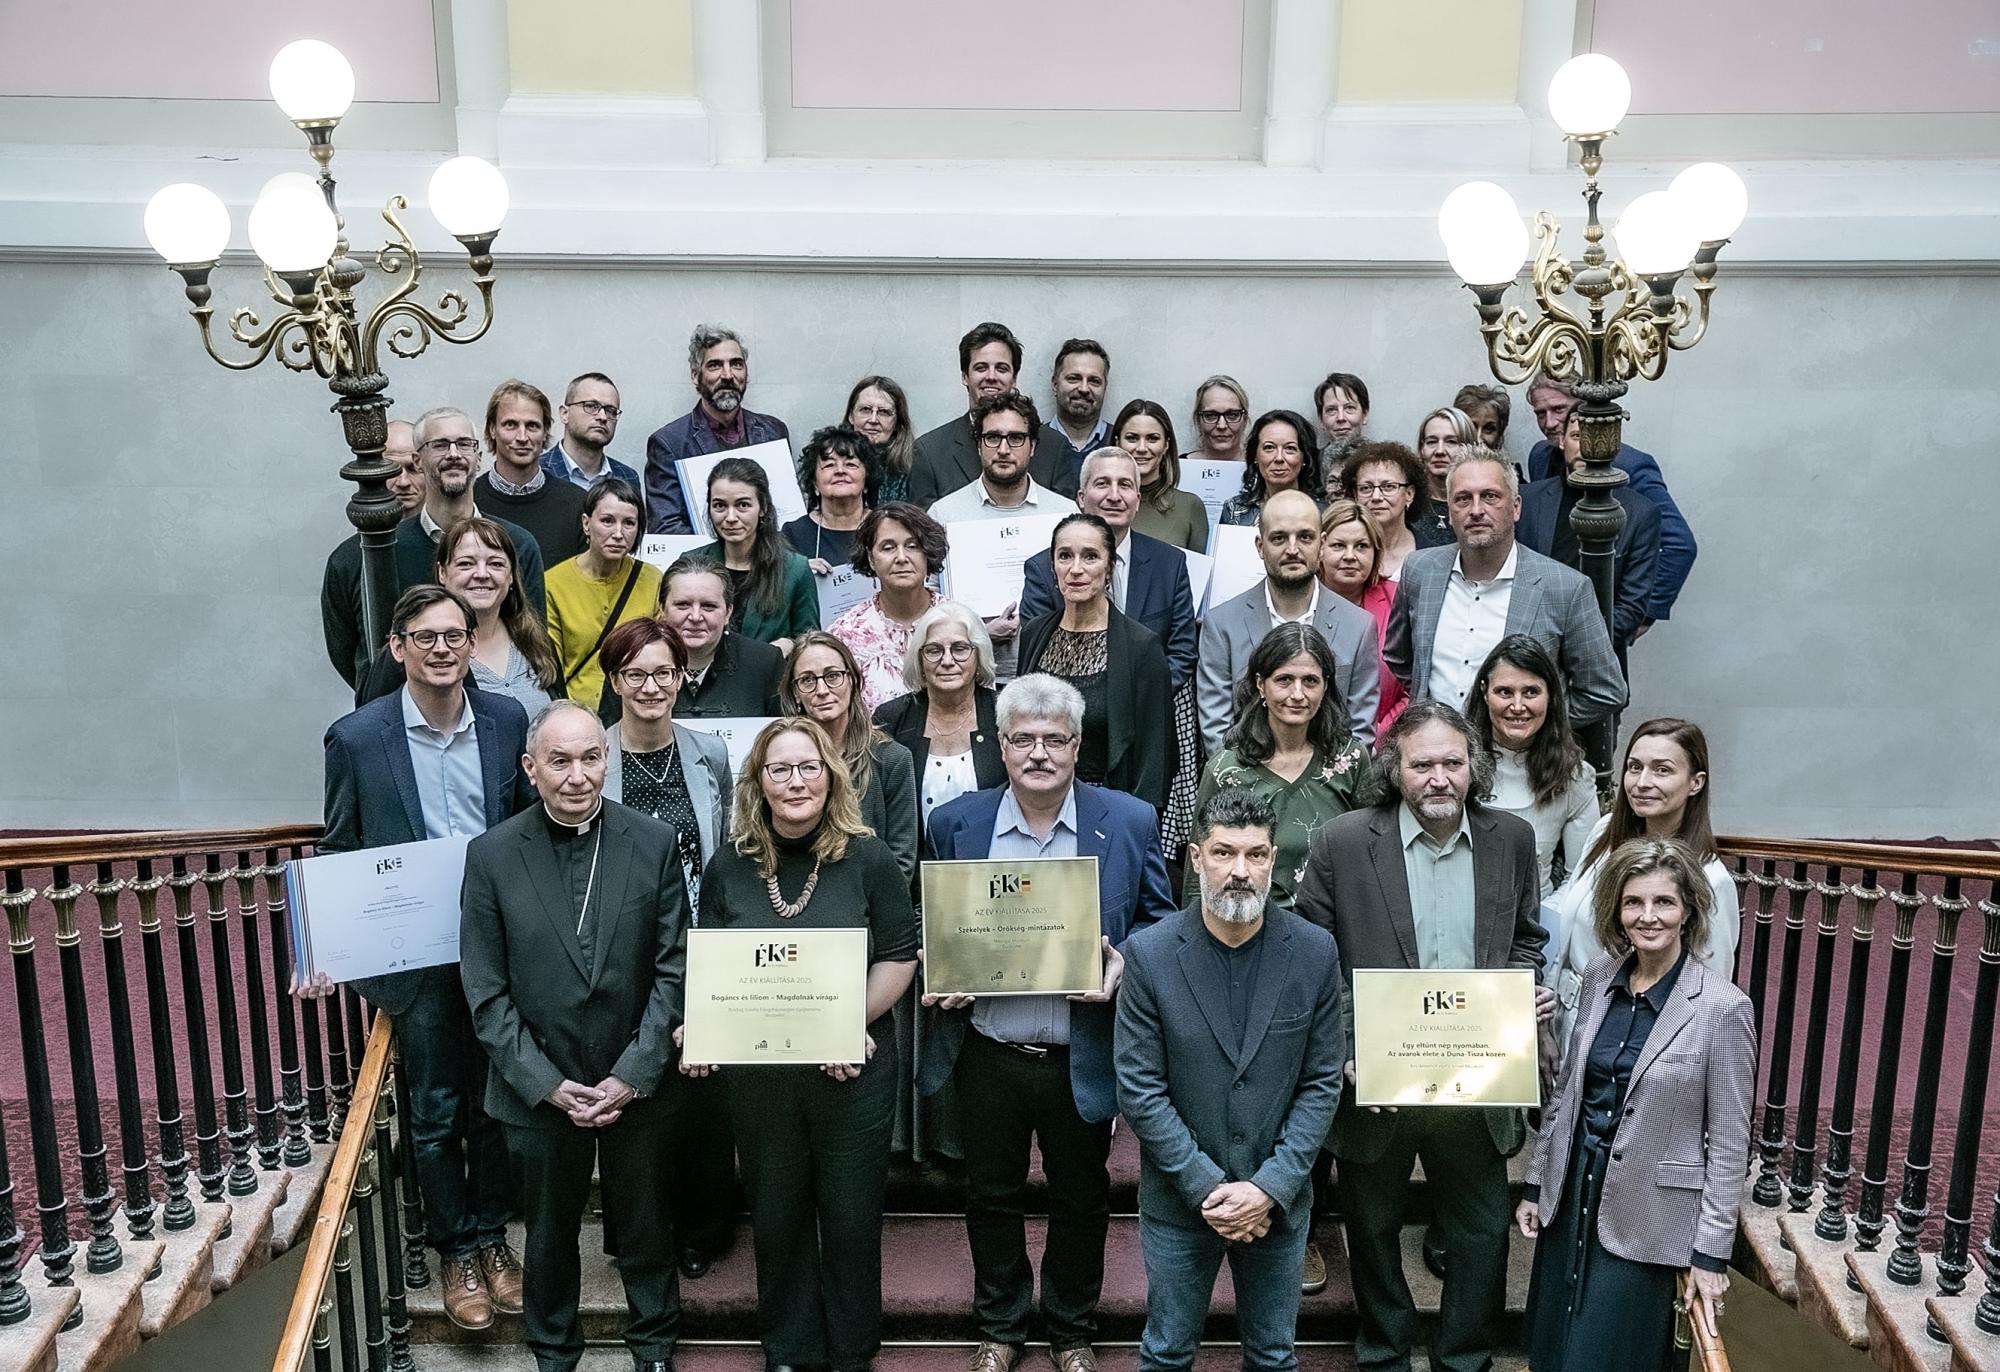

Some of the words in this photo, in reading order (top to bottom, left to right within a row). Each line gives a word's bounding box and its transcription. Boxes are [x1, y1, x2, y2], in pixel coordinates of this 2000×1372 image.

[958, 926, 991, 934] Székelyek
[796, 976, 812, 984] 2025
[711, 994, 740, 1002] Bogáncs
[776, 994, 814, 1002] Magdolnák
[816, 994, 840, 1002] virágai
[1408, 1024, 1418, 1032] AZ
[1467, 1024, 1482, 1032] 2025
[1402, 1042, 1414, 1050] Egy
[1438, 1042, 1452, 1050] nép
